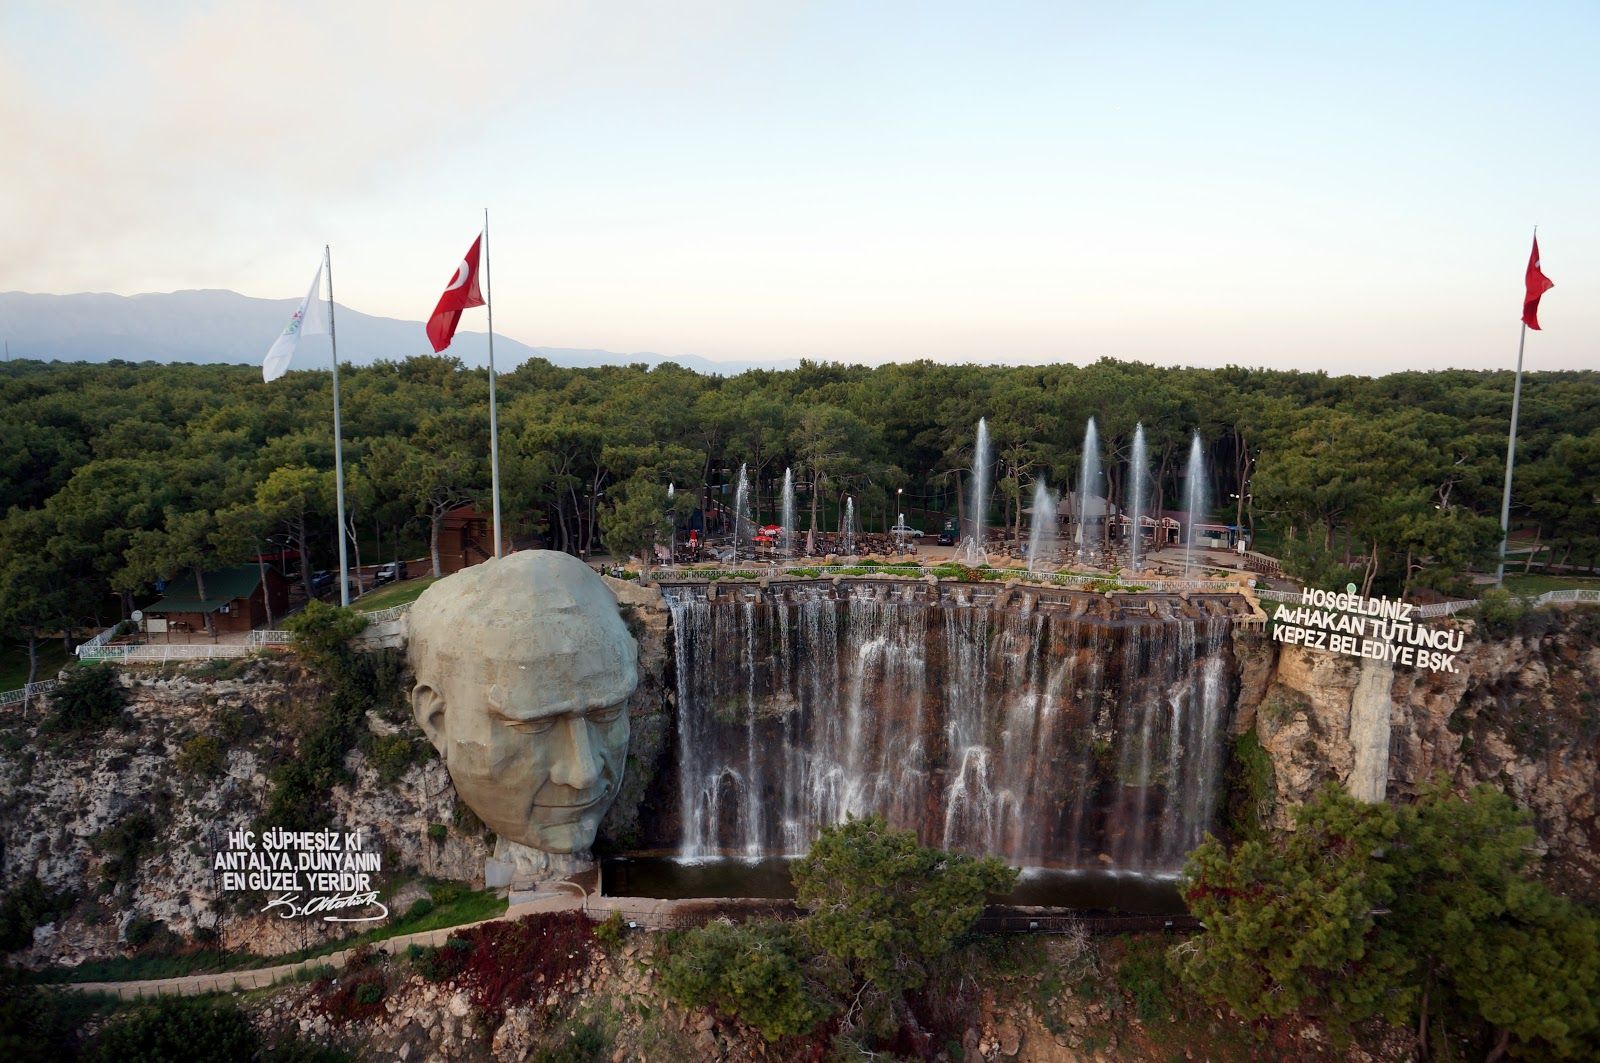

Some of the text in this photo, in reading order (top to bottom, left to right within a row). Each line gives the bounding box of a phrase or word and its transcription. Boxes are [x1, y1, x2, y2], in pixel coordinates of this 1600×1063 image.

[1302, 587, 1413, 622] HOŞGELDİNİZ
[1272, 623, 1460, 674] KEPEZ BELEDİYE BŞK.
[1370, 617, 1464, 652] TÜTÜNCÜ
[228, 826, 362, 853] HİÇ ŞÜPHESİZ Kİ
[223, 868, 371, 892] EN GÜZEL YERİDİR
